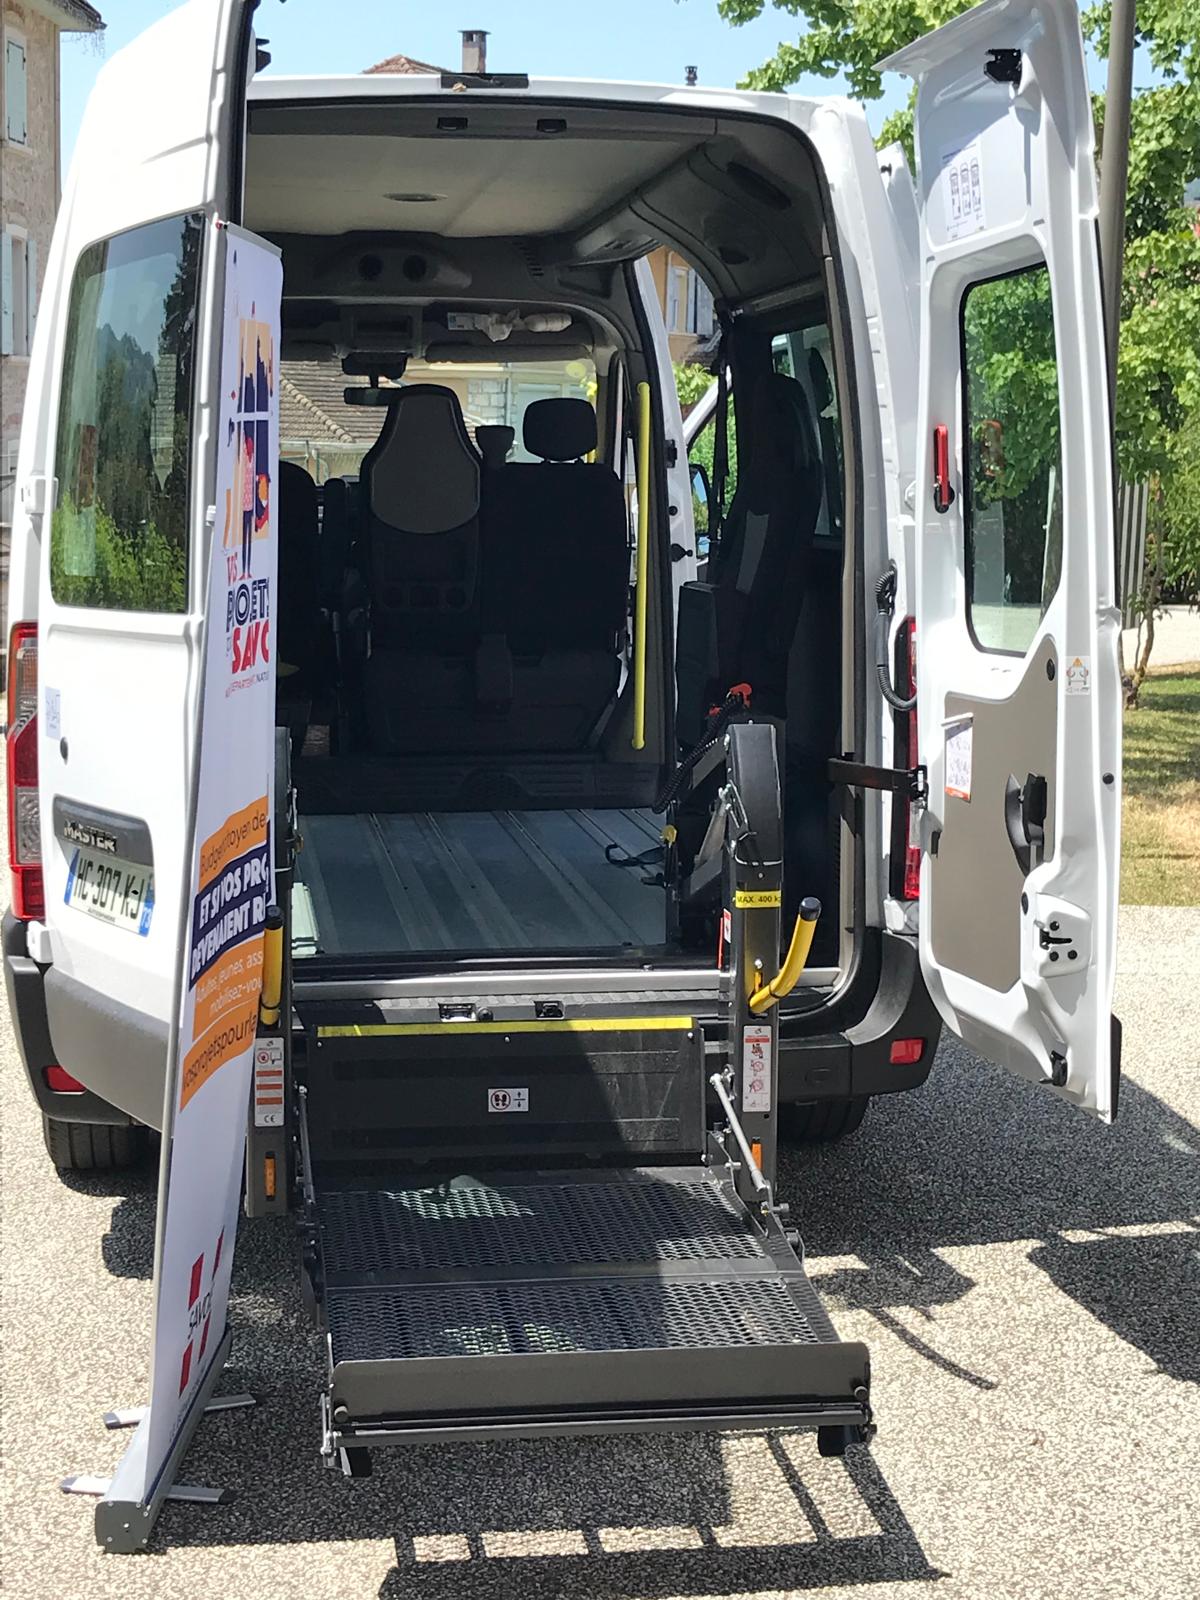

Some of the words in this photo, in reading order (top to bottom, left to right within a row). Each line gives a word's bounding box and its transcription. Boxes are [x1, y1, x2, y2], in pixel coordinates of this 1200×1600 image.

[252, 810, 266, 832] de
[63, 820, 117, 851] MASTER
[758, 895, 773, 903] 400
